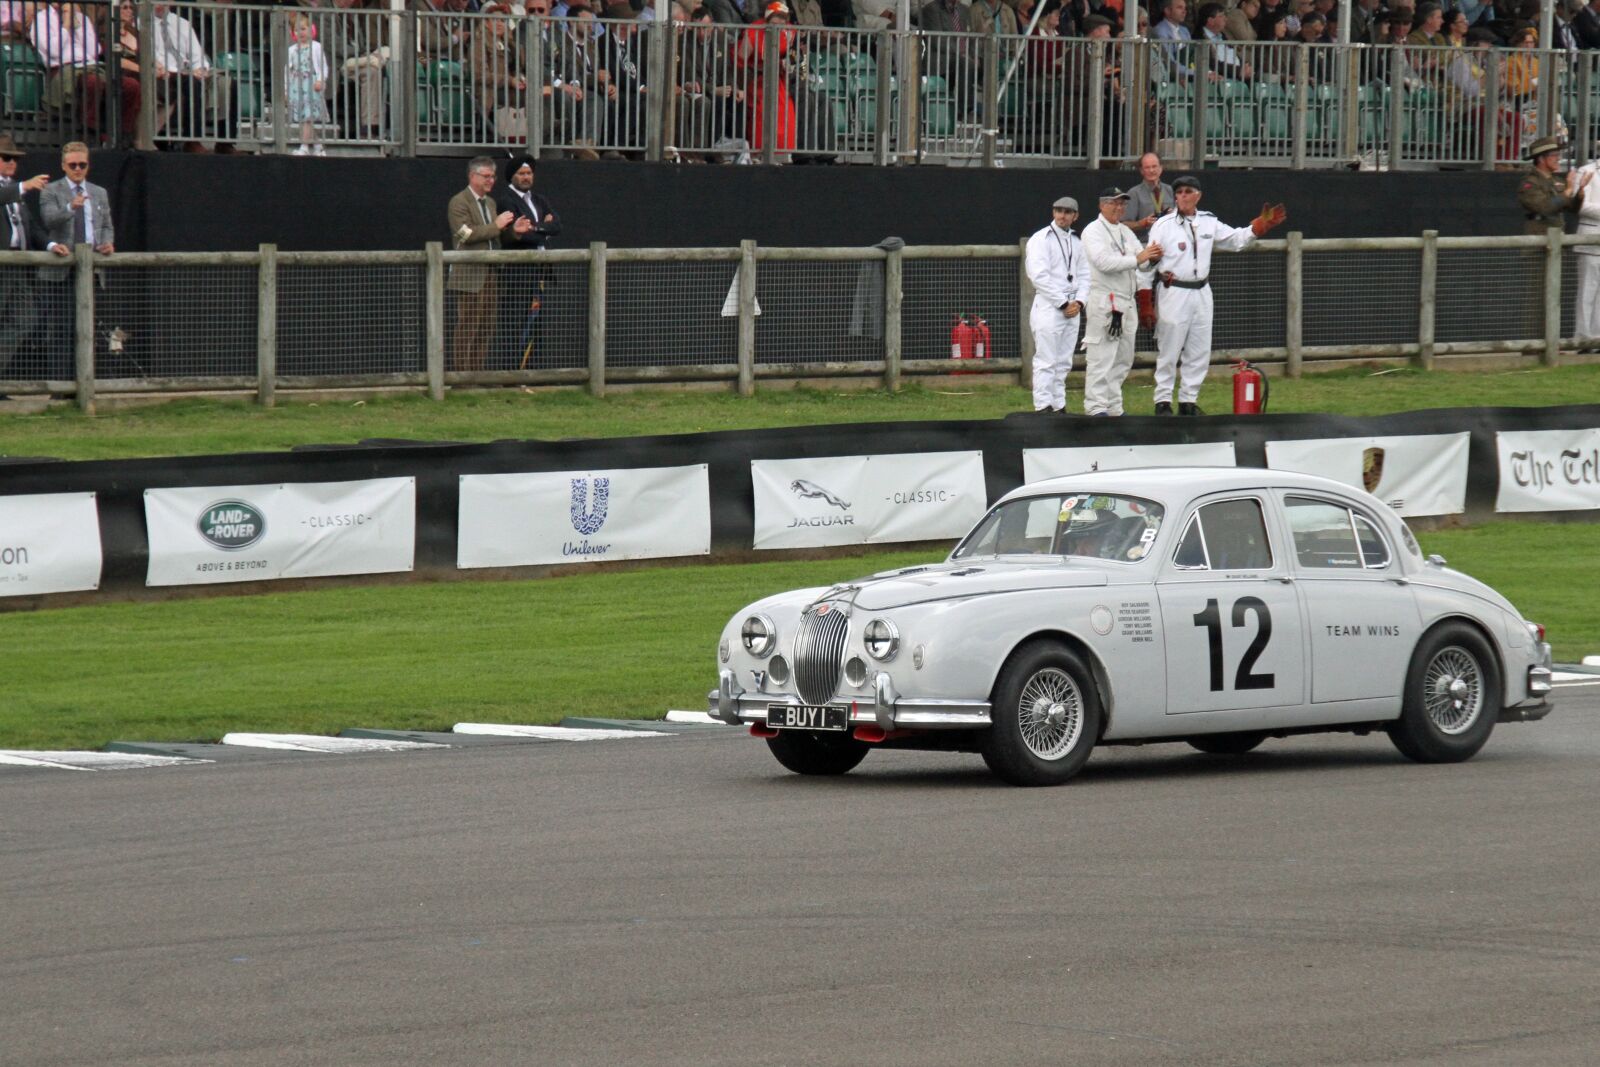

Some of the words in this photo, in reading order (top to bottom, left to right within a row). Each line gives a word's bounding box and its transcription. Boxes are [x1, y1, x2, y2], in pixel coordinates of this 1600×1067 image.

[1511, 450, 1554, 494] The
[209, 509, 243, 524] LAND
[787, 514, 854, 528] JAGUAR
[214, 523, 255, 538] ROVER
[562, 540, 611, 556] Unilever
[0, 547, 28, 565] on
[196, 562, 224, 572] ABOVE
[235, 559, 268, 570] BEYOND
[1326, 625, 1361, 636] TEAM
[1367, 625, 1400, 636] WINS
[1193, 595, 1275, 692] 12
[786, 706, 818, 727] BUY
